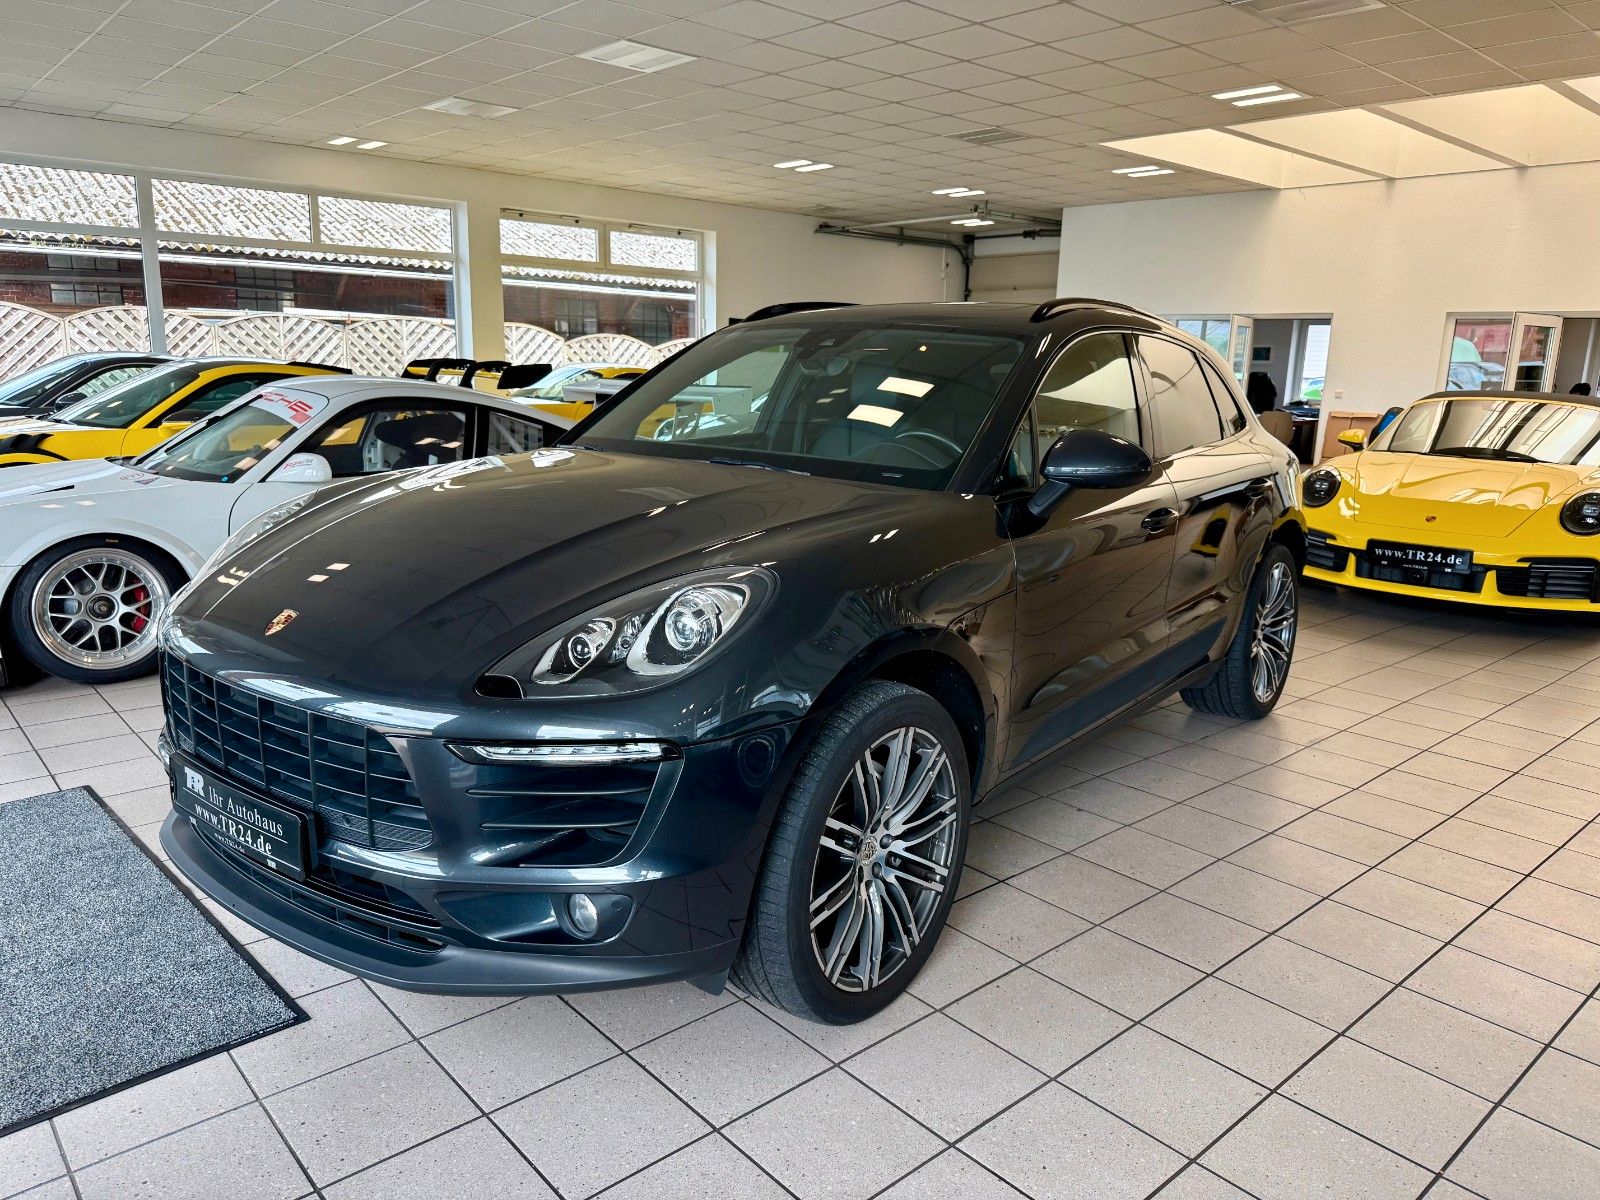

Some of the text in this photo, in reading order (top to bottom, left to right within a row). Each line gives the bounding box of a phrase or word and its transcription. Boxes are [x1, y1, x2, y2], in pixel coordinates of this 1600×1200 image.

[1374, 548, 1463, 565] www.TR24.de
[194, 804, 273, 855] www.TR24.de
[208, 785, 223, 808] Ihr
[227, 797, 283, 836] Autohaus
